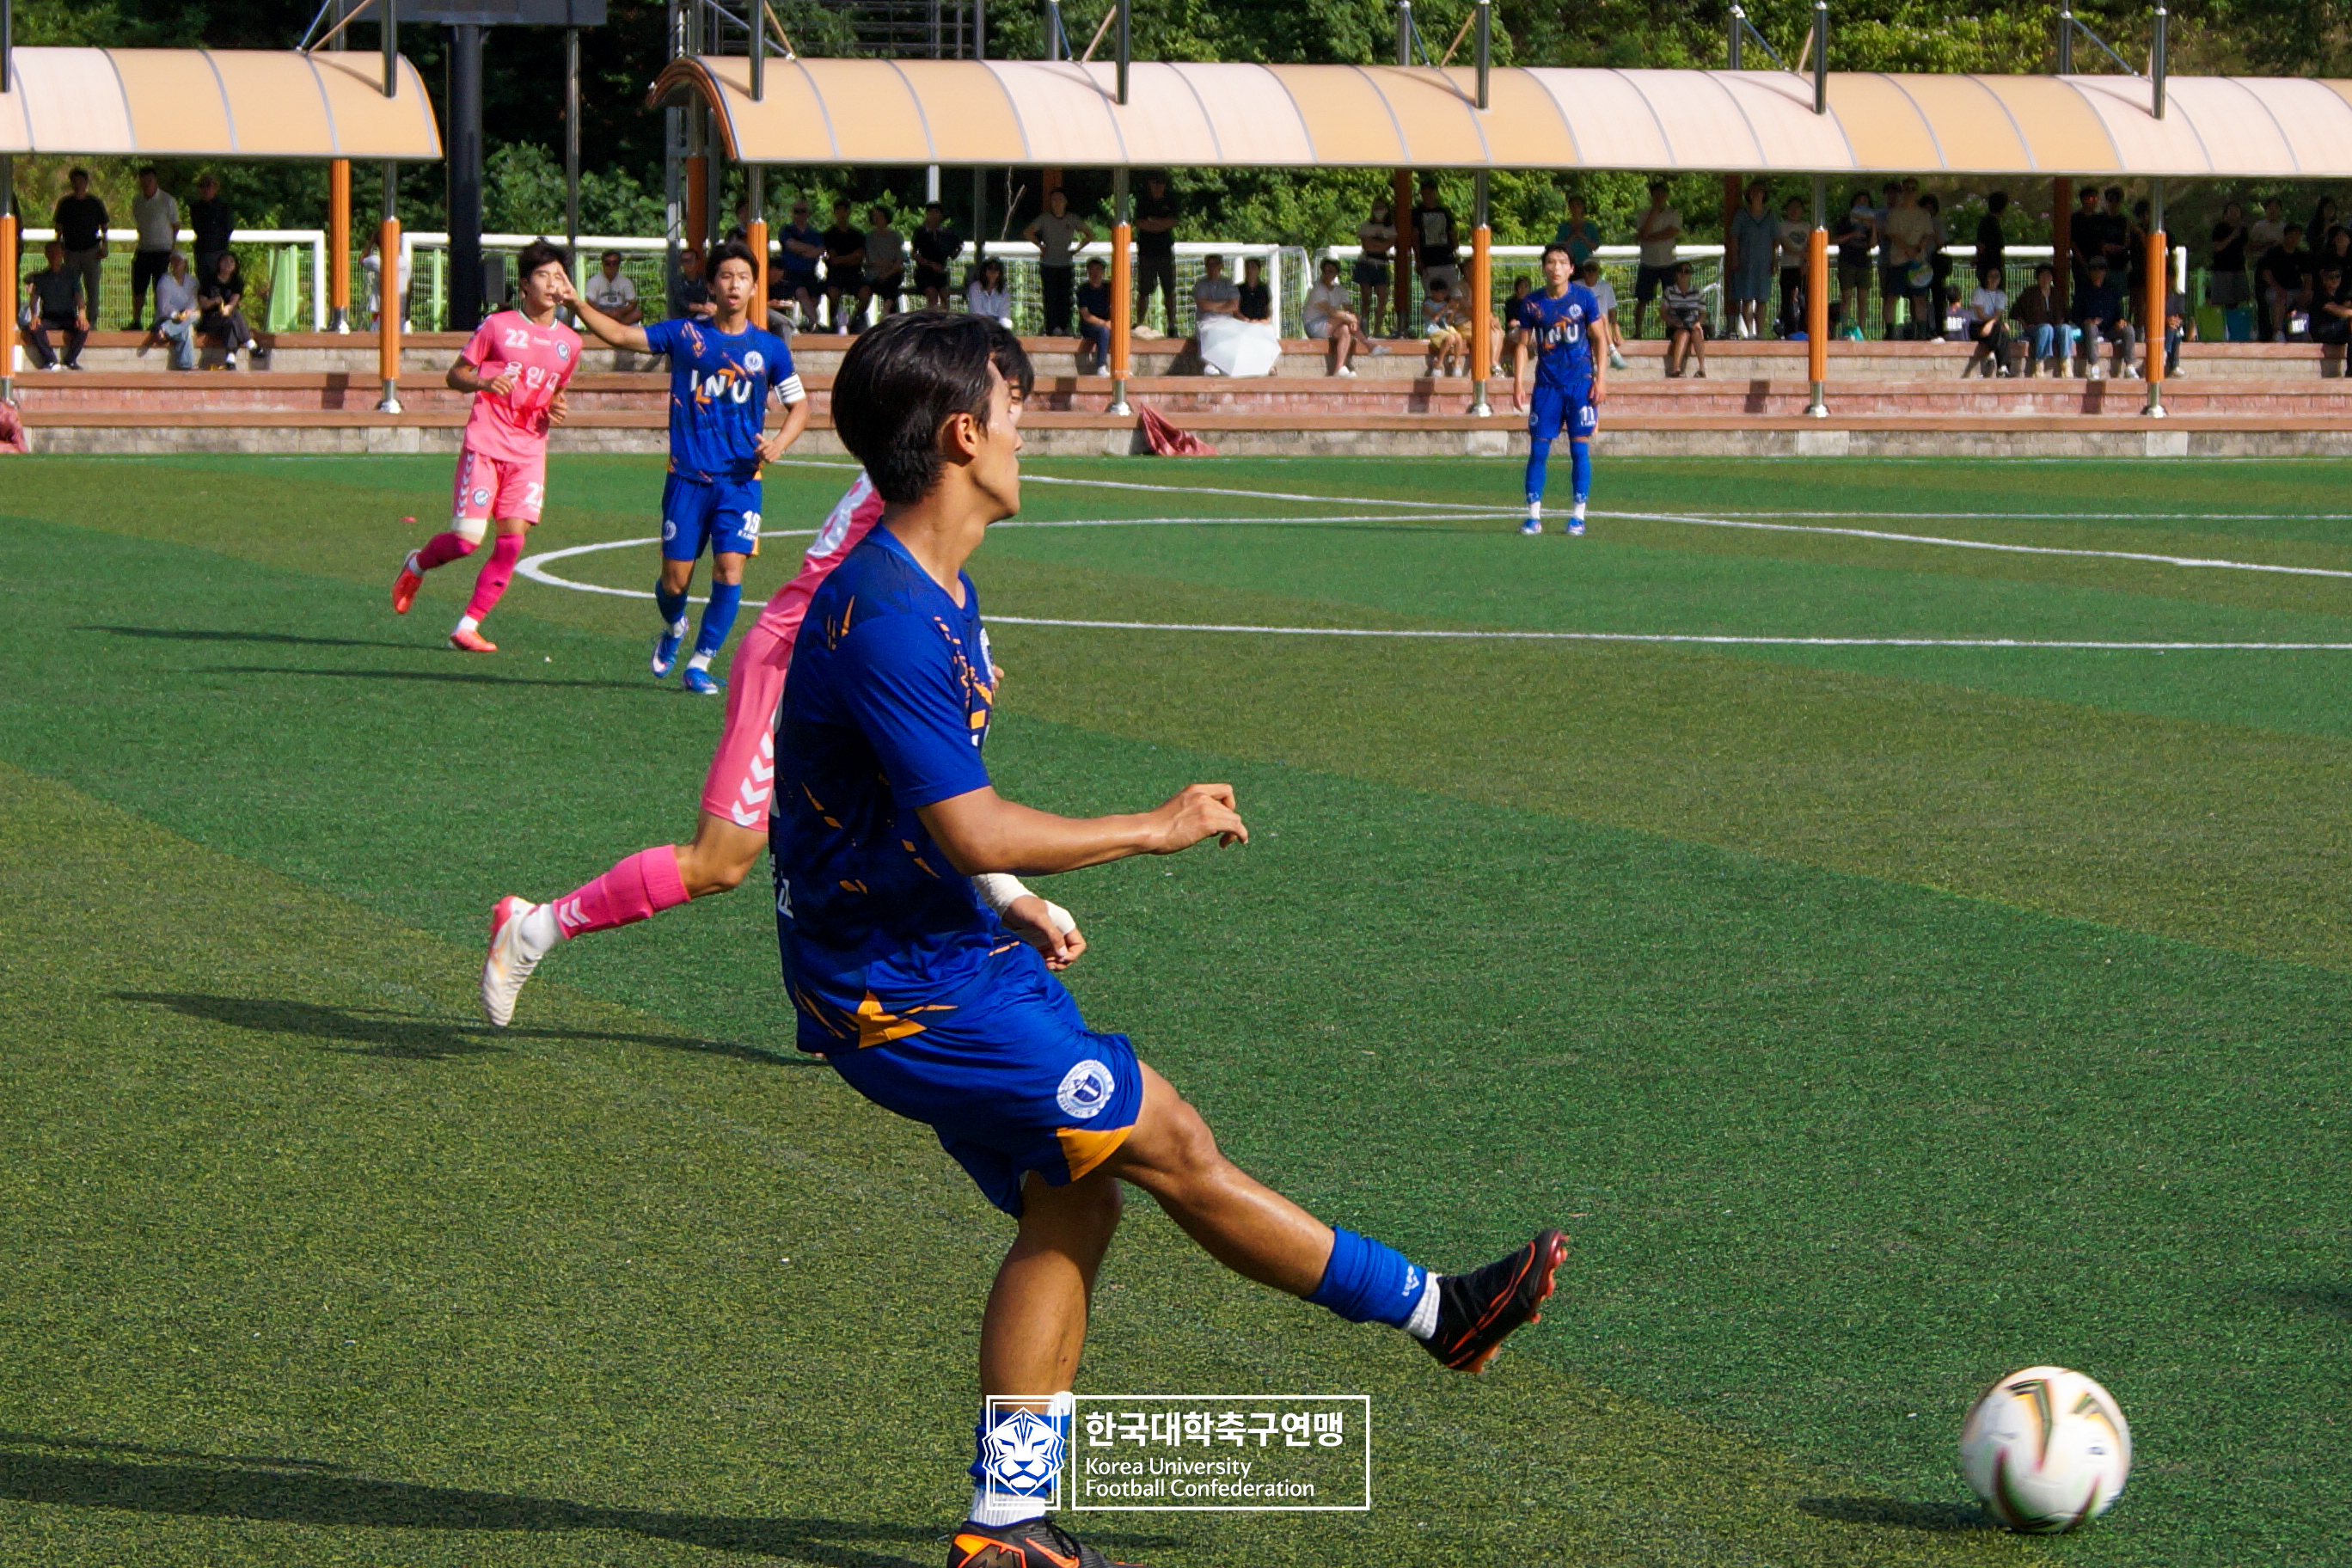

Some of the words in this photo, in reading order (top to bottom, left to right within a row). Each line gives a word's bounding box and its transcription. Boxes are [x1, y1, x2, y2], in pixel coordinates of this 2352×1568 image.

[504, 328, 530, 348] 22
[1539, 323, 1579, 343] INU
[690, 369, 753, 404] INU
